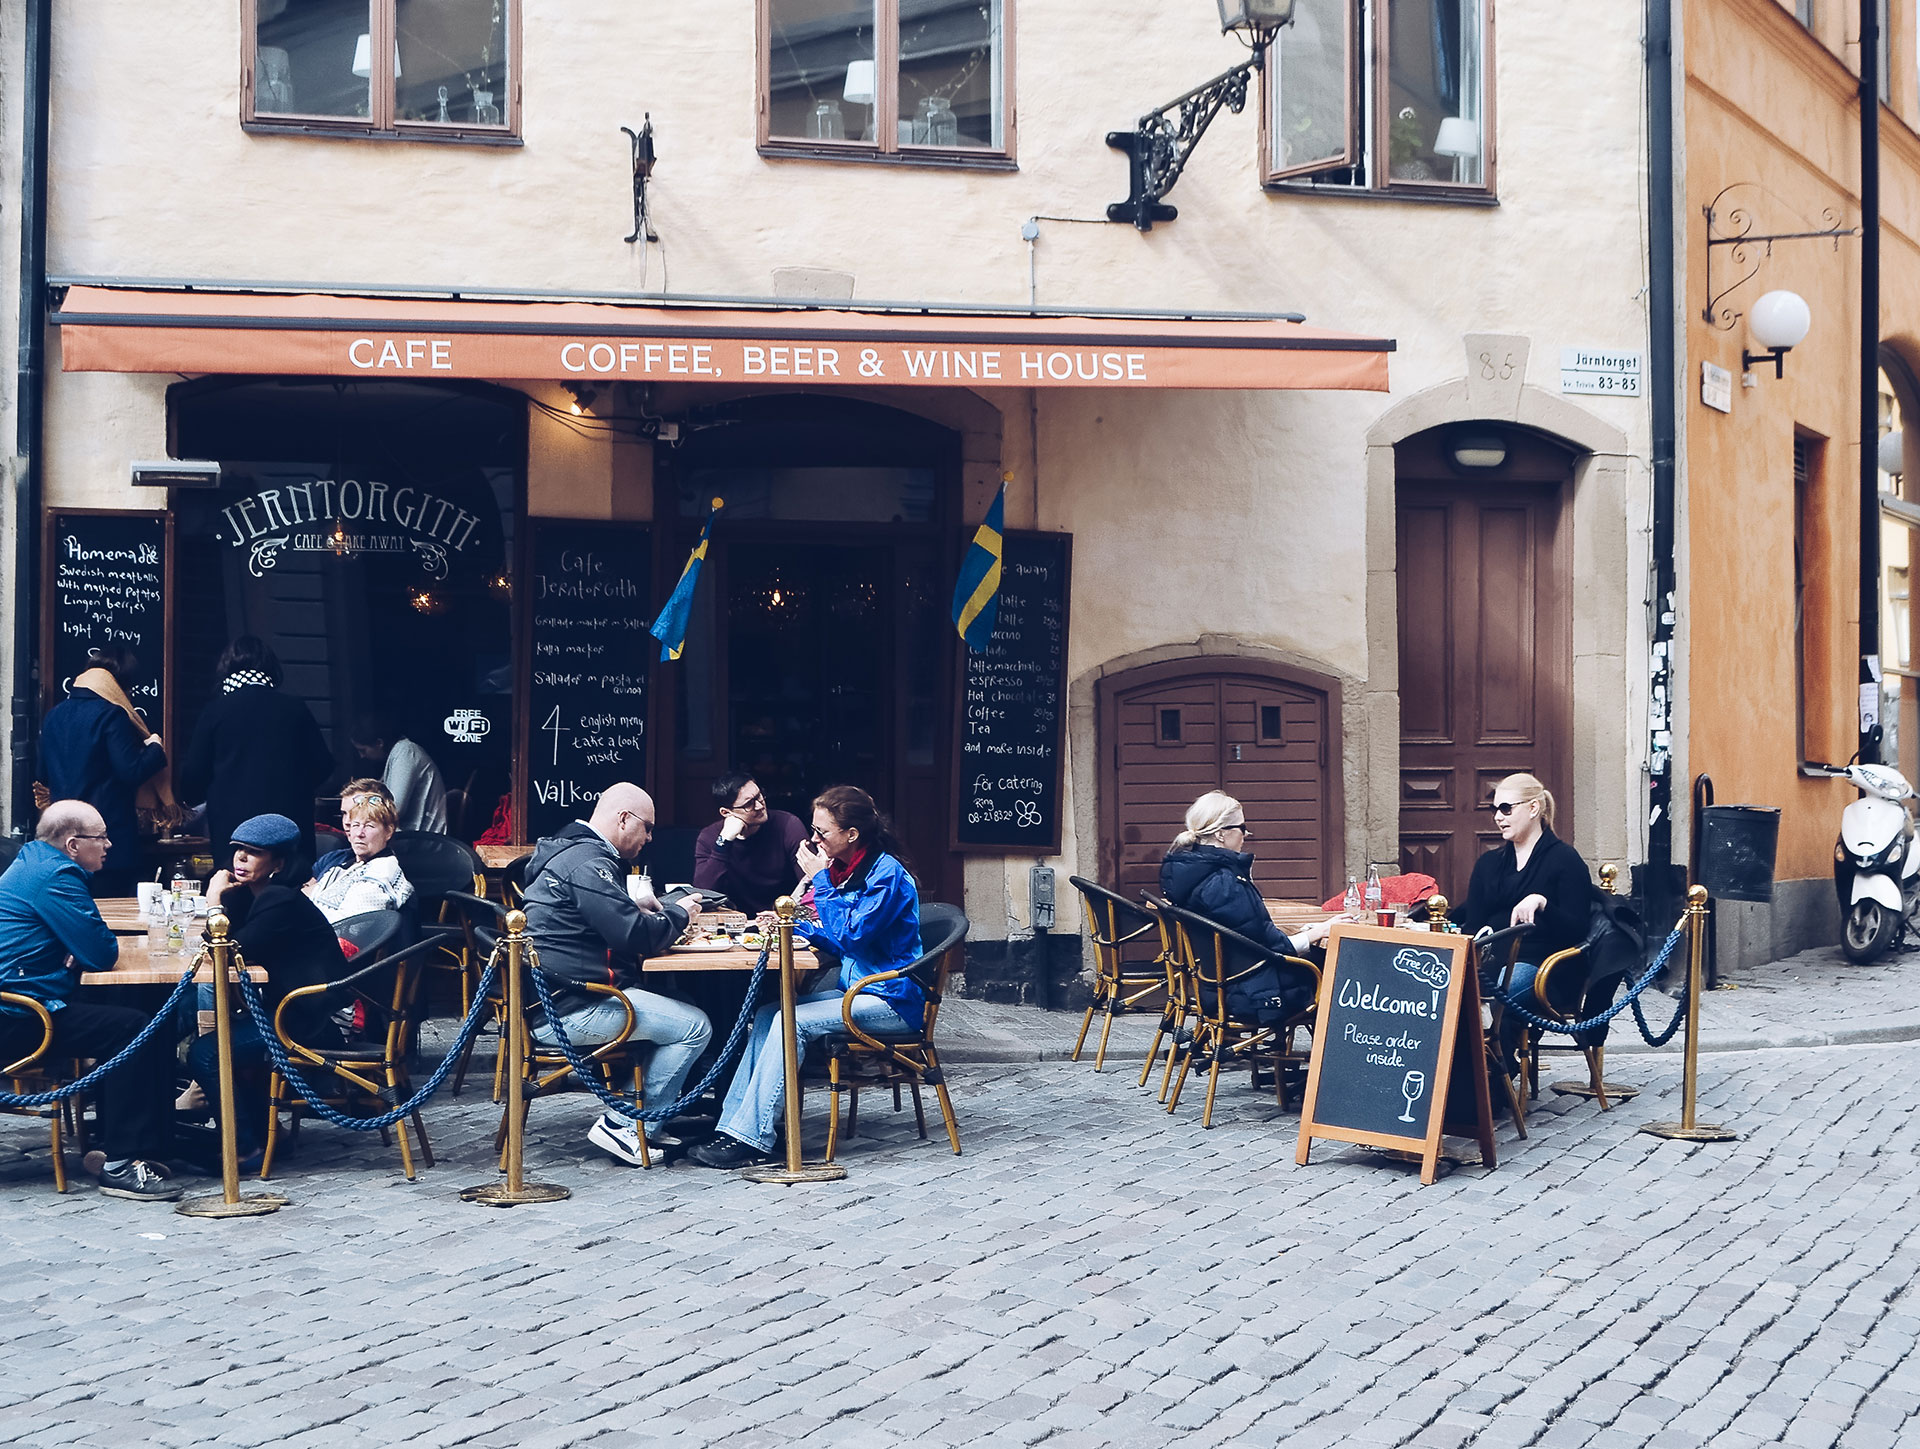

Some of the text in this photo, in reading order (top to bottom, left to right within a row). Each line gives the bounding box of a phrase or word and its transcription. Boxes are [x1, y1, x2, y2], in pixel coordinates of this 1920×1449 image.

[348, 338, 1147, 381] CAFE COFFEE, BEER & WINE HOUSE
[1576, 353, 1637, 371] Järntorget
[1599, 376, 1636, 390] 83-85
[221, 479, 481, 551] JERNTORGITH
[63, 535, 159, 564] Homemade
[294, 533, 323, 549] CAFE
[369, 535, 404, 550] AWAY
[561, 550, 603, 577] Cafe
[59, 564, 159, 584] Swedish meatballs
[1015, 563, 1048, 583] away
[83, 582, 122, 597] mashed
[63, 594, 145, 614] Lingon berries
[91, 611, 113, 623] and
[63, 621, 141, 645] light gravy
[565, 643, 605, 659] mackor
[534, 670, 583, 687] Sallader
[601, 674, 632, 689] pasta
[968, 675, 1023, 689] espresso
[967, 690, 985, 702] Hot
[453, 709, 482, 718] FREE
[968, 705, 1006, 721] Coffee
[580, 713, 616, 735] english
[968, 721, 990, 735] Tea
[452, 734, 482, 743] ZONE
[571, 735, 641, 751] take a look
[586, 749, 623, 766] inside
[964, 741, 1052, 758] and more inside
[972, 773, 993, 796] för
[1398, 952, 1421, 970] Free
[1338, 978, 1440, 1020] Welcome!
[1344, 1022, 1422, 1050] Please order
